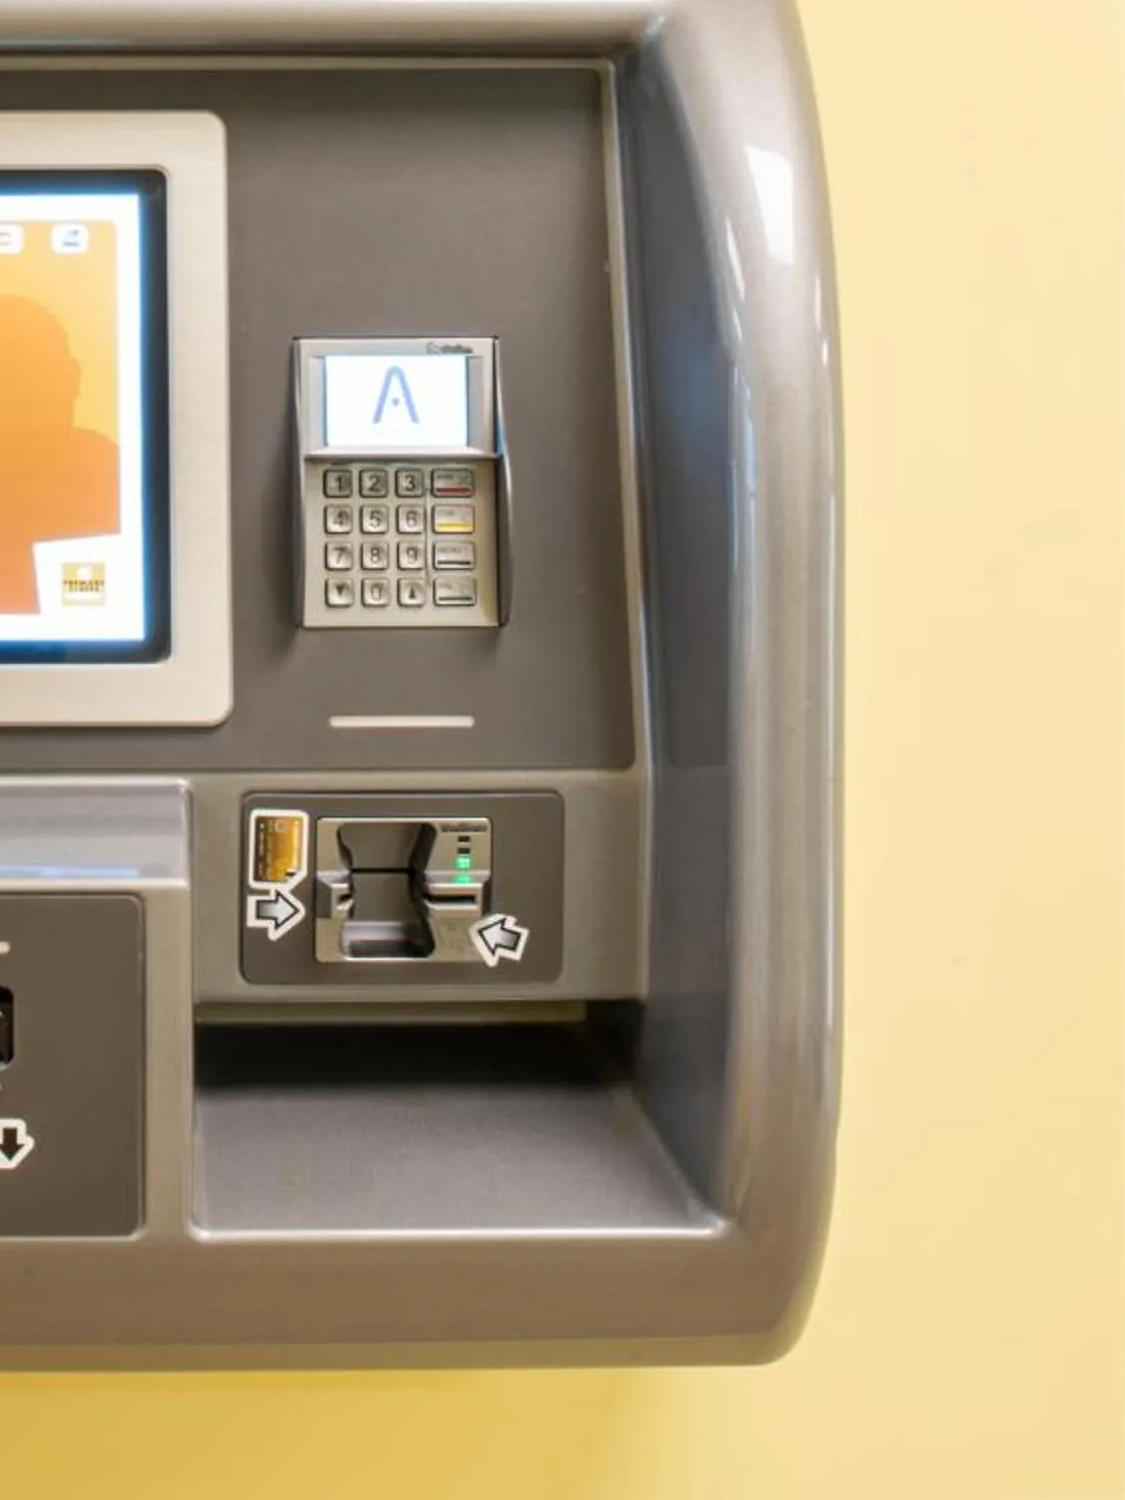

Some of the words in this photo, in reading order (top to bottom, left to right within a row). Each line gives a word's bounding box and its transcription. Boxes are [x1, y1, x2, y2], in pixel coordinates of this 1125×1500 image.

[369, 474, 381, 492] 2
[405, 474, 416, 492] 3
[369, 510, 381, 528] 5
[406, 510, 418, 527] 6
